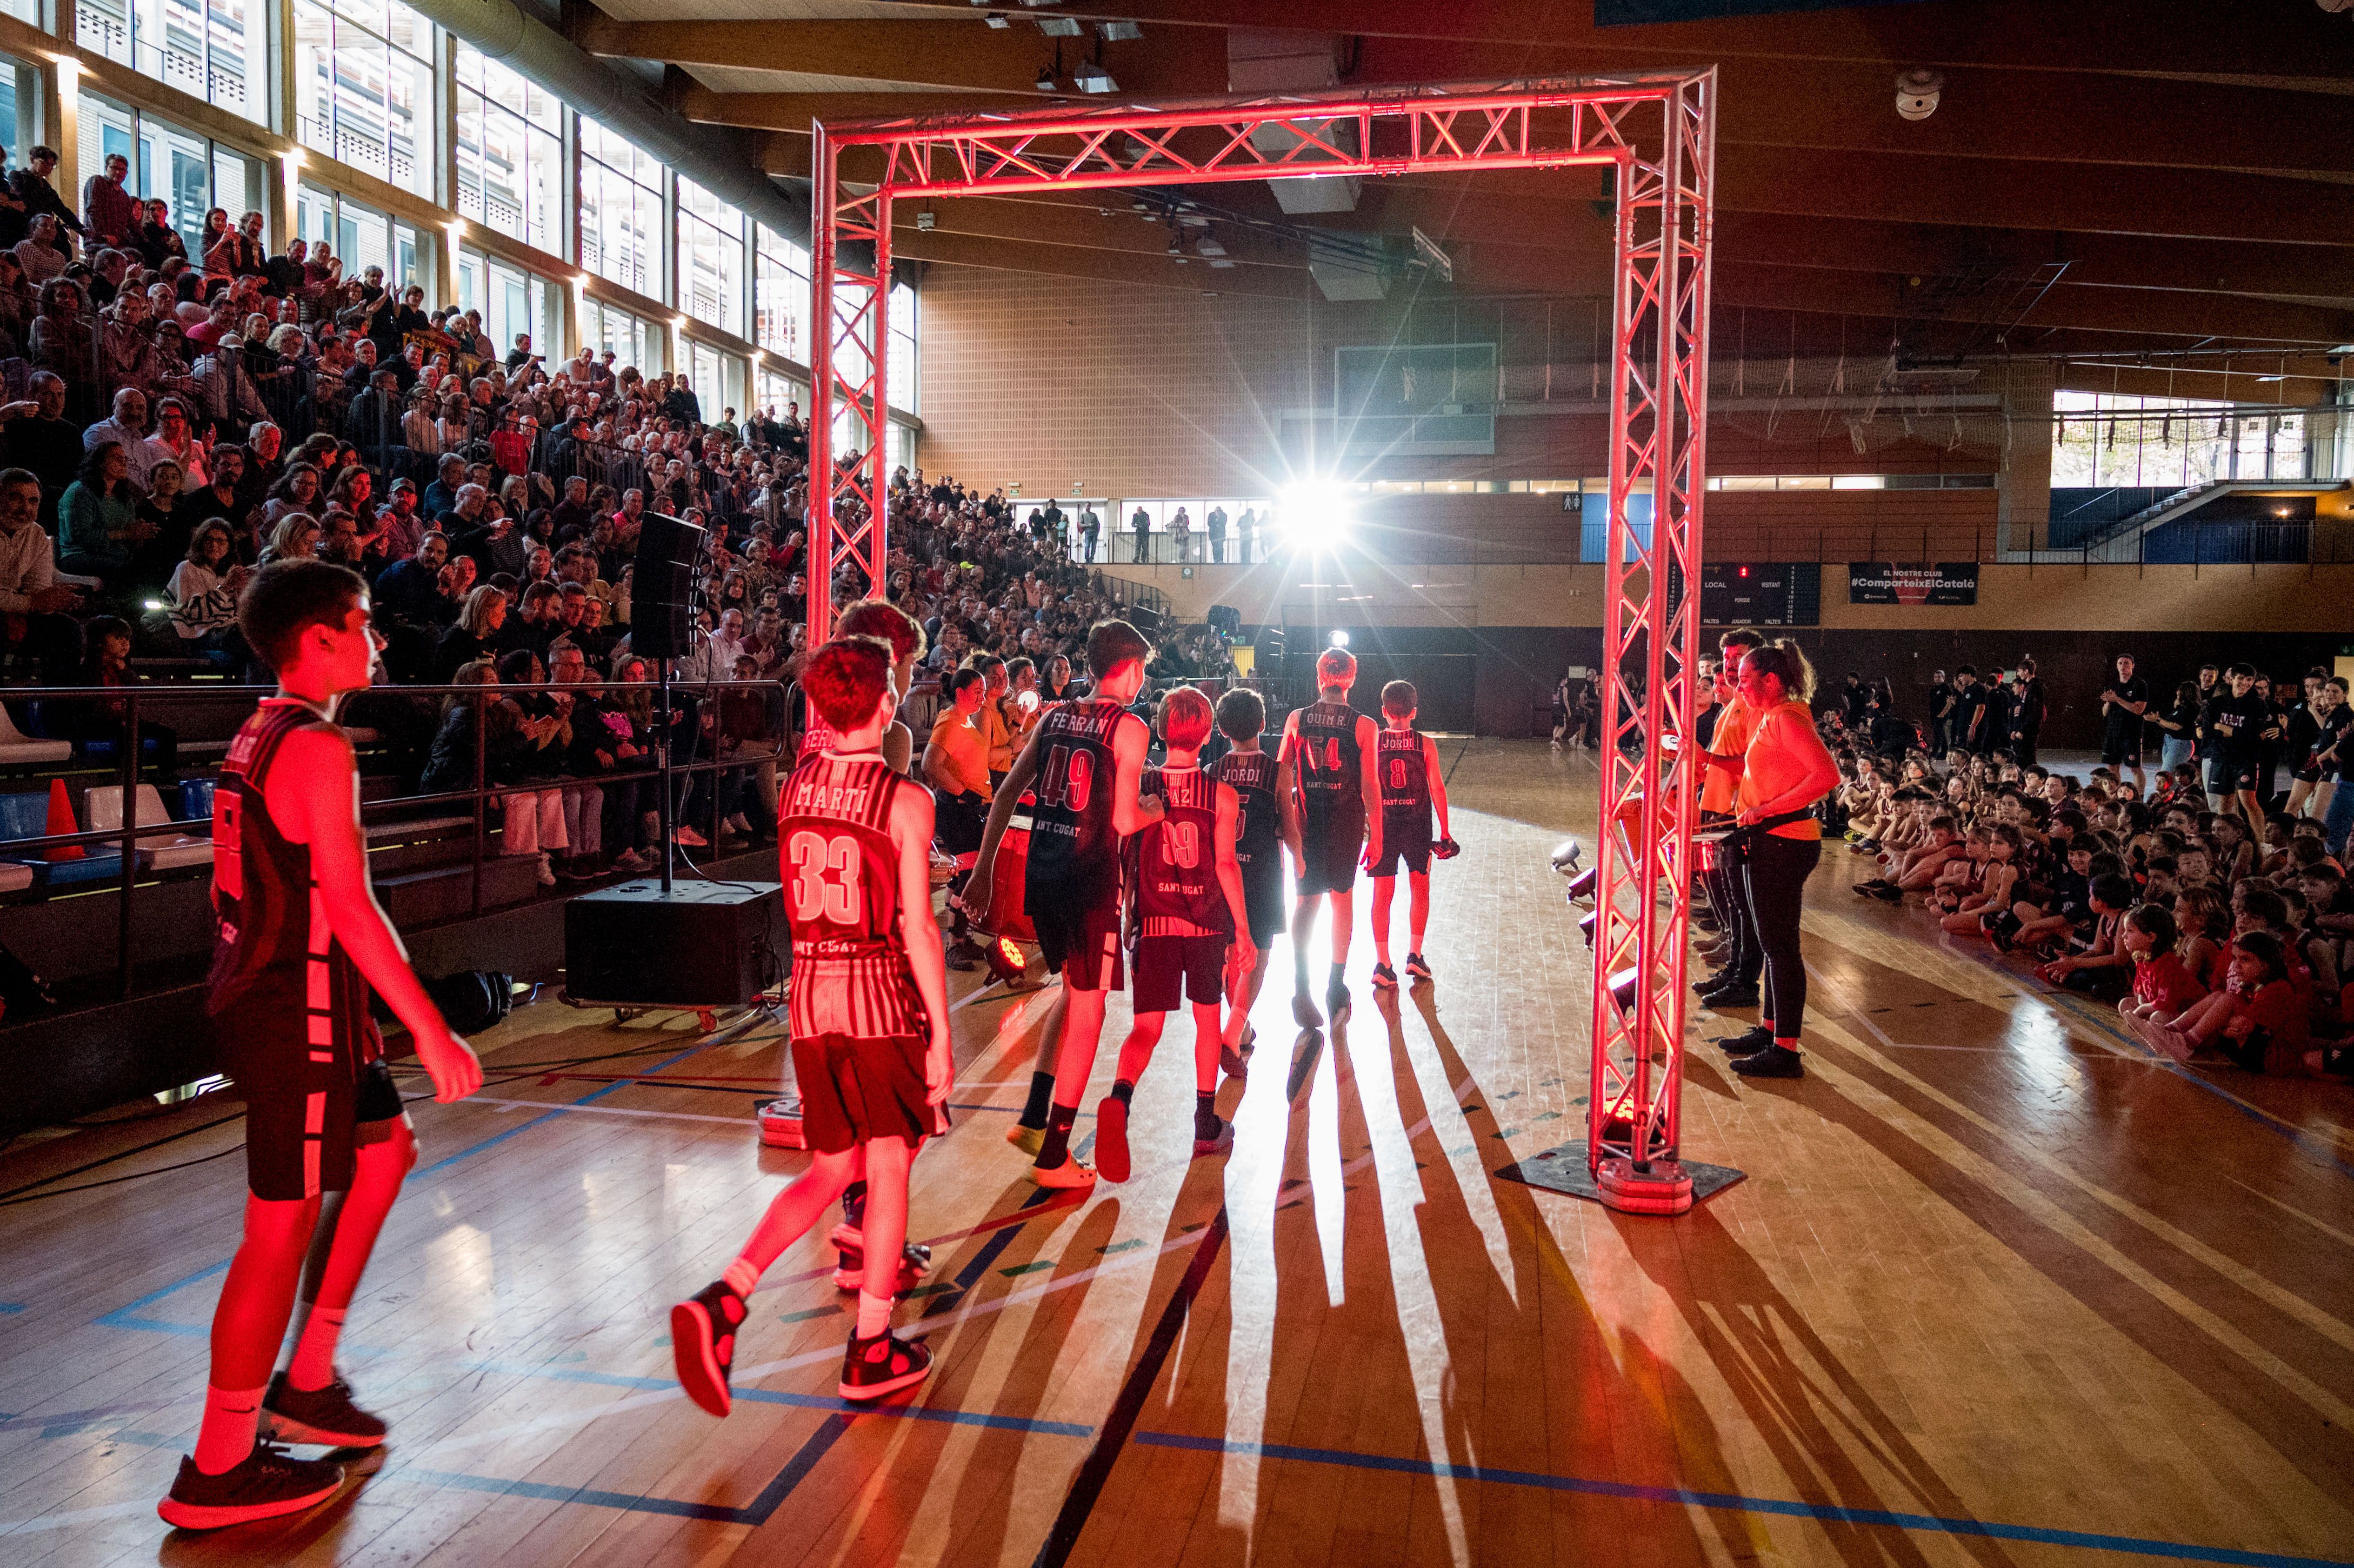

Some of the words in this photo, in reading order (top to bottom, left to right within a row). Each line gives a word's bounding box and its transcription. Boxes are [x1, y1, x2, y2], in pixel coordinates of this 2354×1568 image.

[1851, 578, 1975, 590] #ComparteixElCatalà
[1050, 712, 1108, 736] FERRAN
[1307, 713, 1335, 725] QUIM
[1337, 715, 1346, 726] R.
[1383, 738, 1412, 749] JORDI
[1305, 736, 1342, 771] 54
[1040, 744, 1096, 812] 49
[1222, 769, 1260, 782] JORDI
[1390, 759, 1406, 789] 8
[796, 783, 869, 813] MARTÍ
[1162, 789, 1190, 804] PAZ
[1036, 820, 1052, 831] ANT
[1053, 823, 1081, 837] CUGAT
[790, 831, 861, 924] 33
[1182, 885, 1203, 895] UGAT
